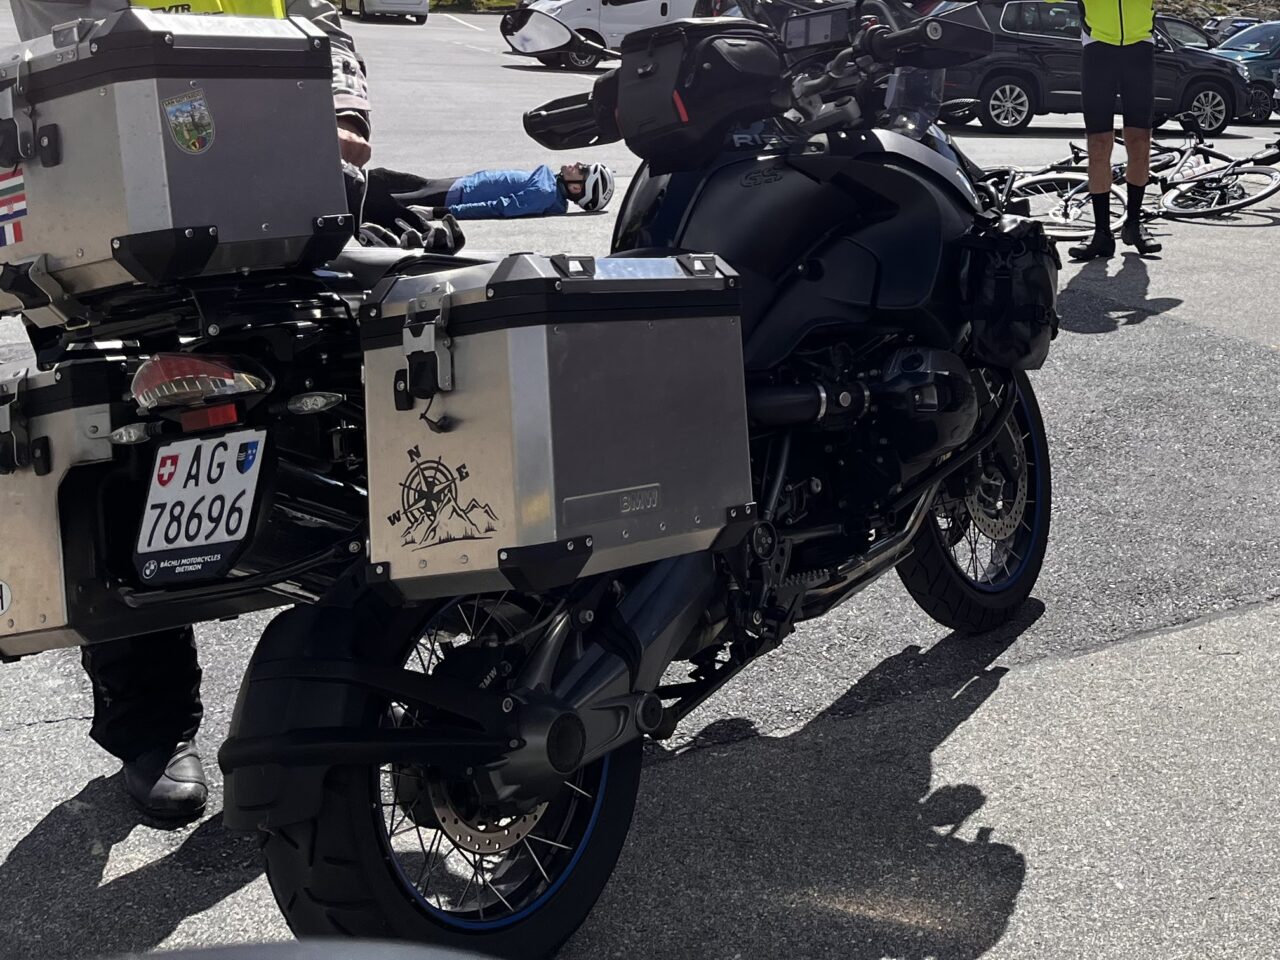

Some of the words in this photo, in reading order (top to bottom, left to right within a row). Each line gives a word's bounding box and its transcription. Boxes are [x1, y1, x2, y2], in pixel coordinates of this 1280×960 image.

[407, 444, 422, 462] N
[182, 441, 229, 489] AG
[456, 463, 470, 482] E
[621, 488, 659, 513] BMW
[147, 489, 246, 548] 78696
[387, 510, 402, 526] W
[181, 553, 222, 566] MOTORCYCLES
